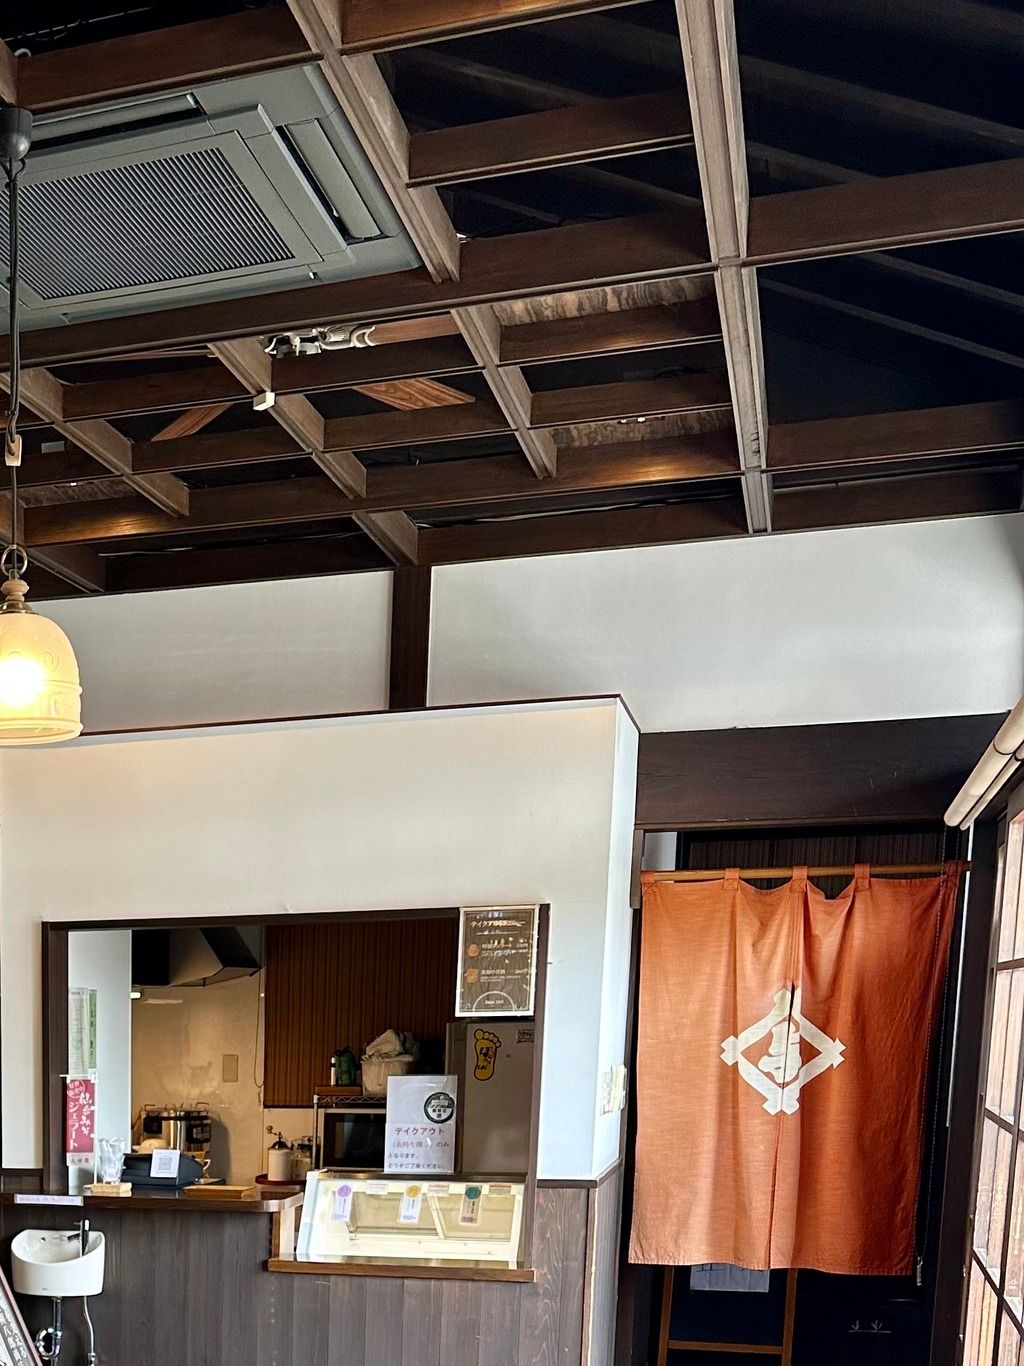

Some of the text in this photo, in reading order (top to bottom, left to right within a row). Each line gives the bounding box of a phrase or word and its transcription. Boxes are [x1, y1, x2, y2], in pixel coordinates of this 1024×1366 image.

[394, 1127, 445, 1136] テイクアウト
